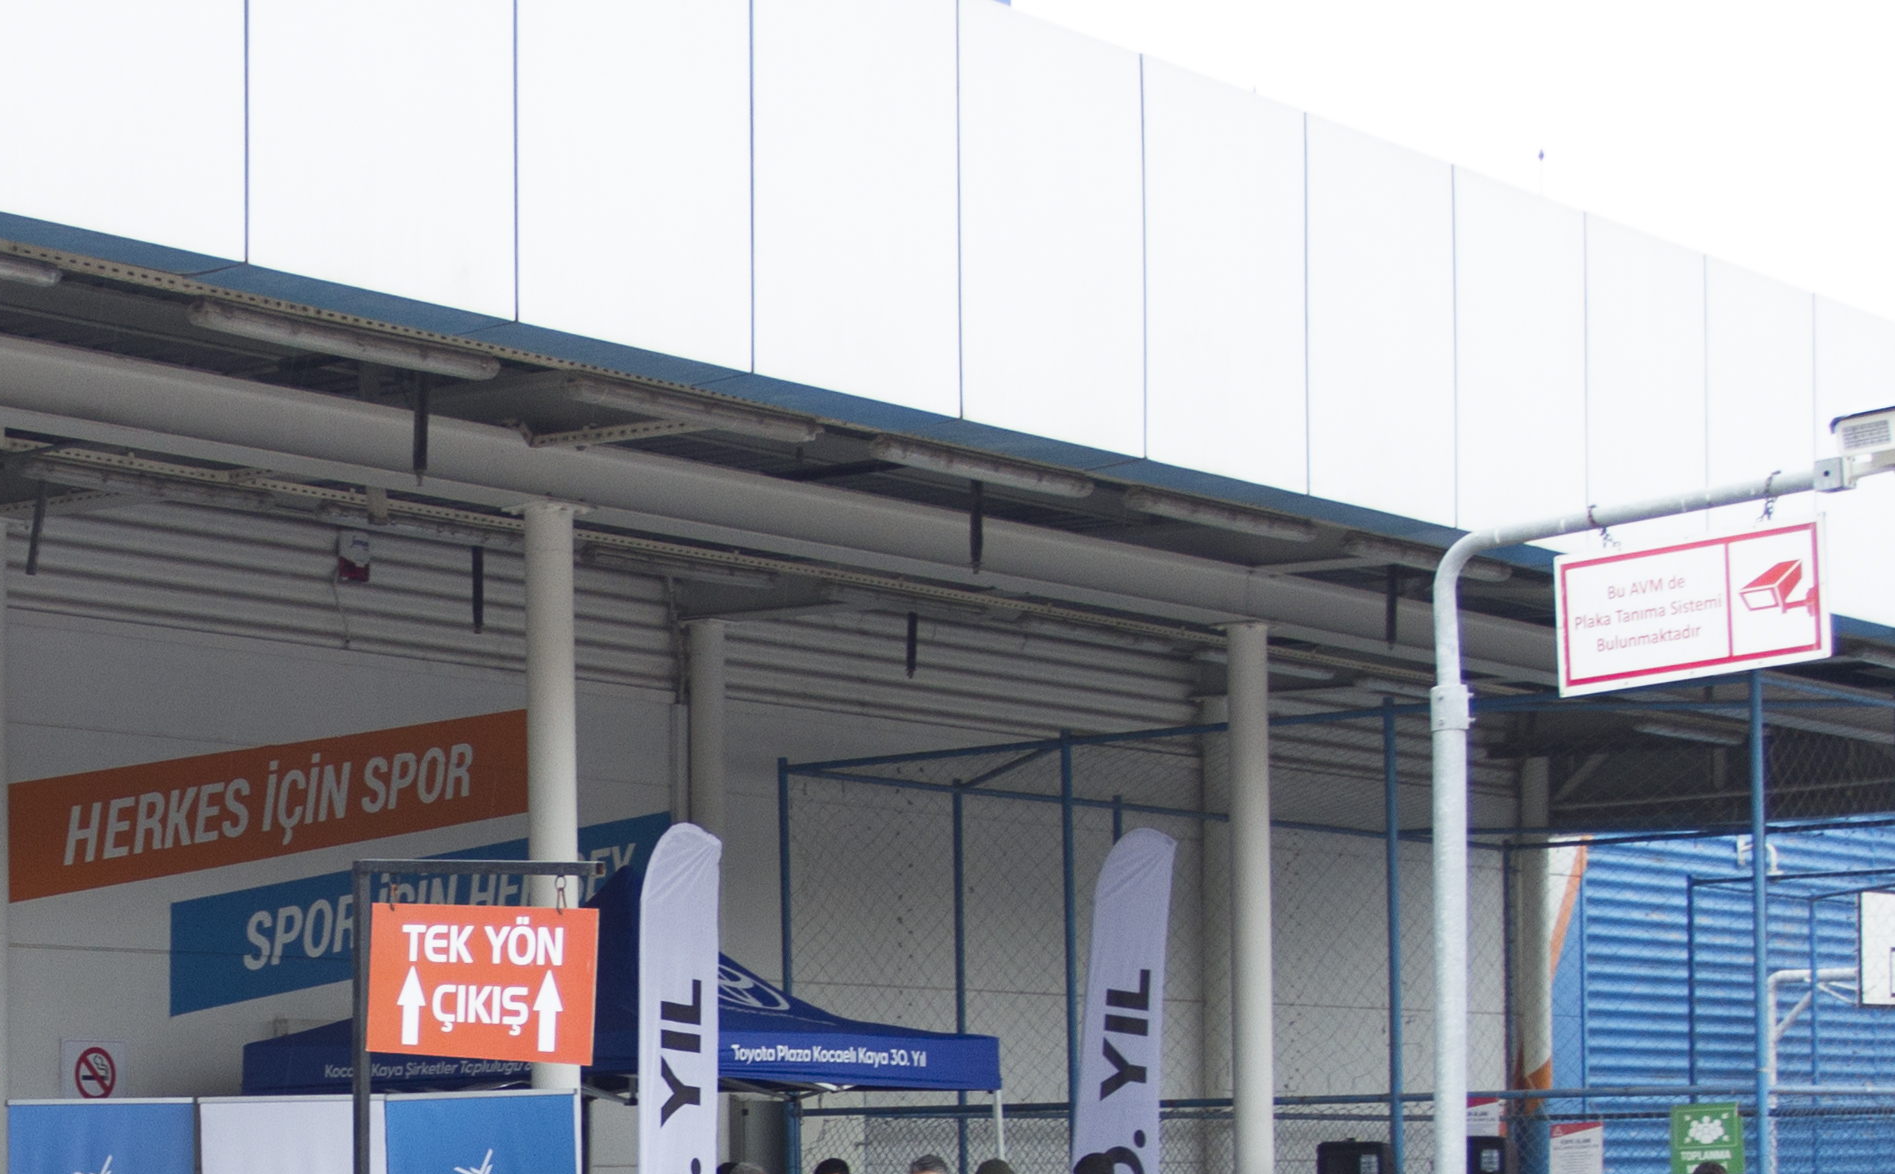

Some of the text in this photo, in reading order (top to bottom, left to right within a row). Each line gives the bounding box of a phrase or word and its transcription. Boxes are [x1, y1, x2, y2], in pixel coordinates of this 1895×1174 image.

[1574, 593, 1722, 630] Plaka Tanıma Sistemi
[1607, 575, 1685, 599] Bu AVM de
[1597, 624, 1702, 652] Bulunmaktadır
[63, 742, 475, 867] HERKES İÇİN SPOR
[243, 894, 354, 971] SPOR
[402, 915, 564, 967] TEK YÖN
[432, 982, 530, 1036] ÇIKIŞ
[1101, 968, 1151, 1101] YIL
[371, 1063, 403, 1079] Kaya
[405, 1061, 457, 1079] Şirketler
[660, 978, 703, 1128] YIL
[731, 1044, 776, 1064] Toyota
[777, 1045, 811, 1062] Plaza
[858, 1047, 889, 1068] Kaya
[890, 1049, 910, 1067] 30.
